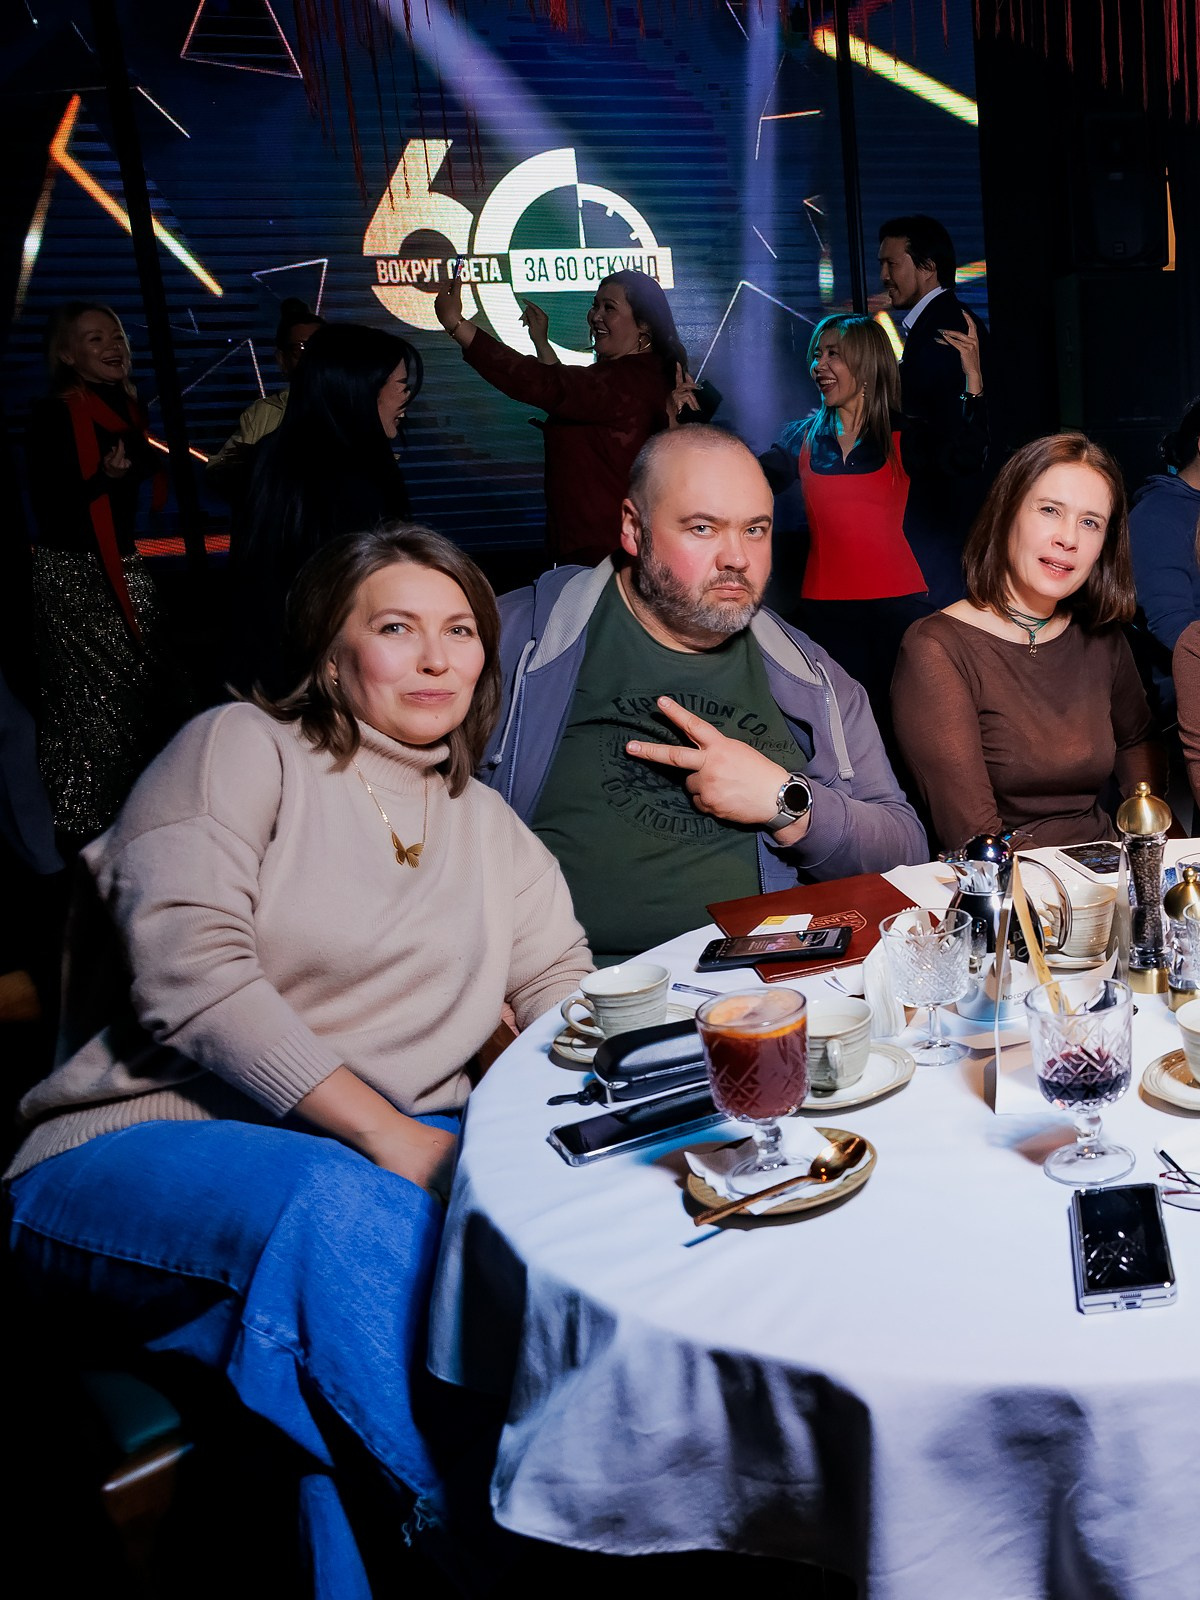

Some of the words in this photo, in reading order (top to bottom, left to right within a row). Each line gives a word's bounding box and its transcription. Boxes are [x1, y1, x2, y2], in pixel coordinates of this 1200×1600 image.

[376, 257, 442, 284] ВОКРУГ
[524, 256, 549, 282] ЗА
[554, 255, 578, 281] 60
